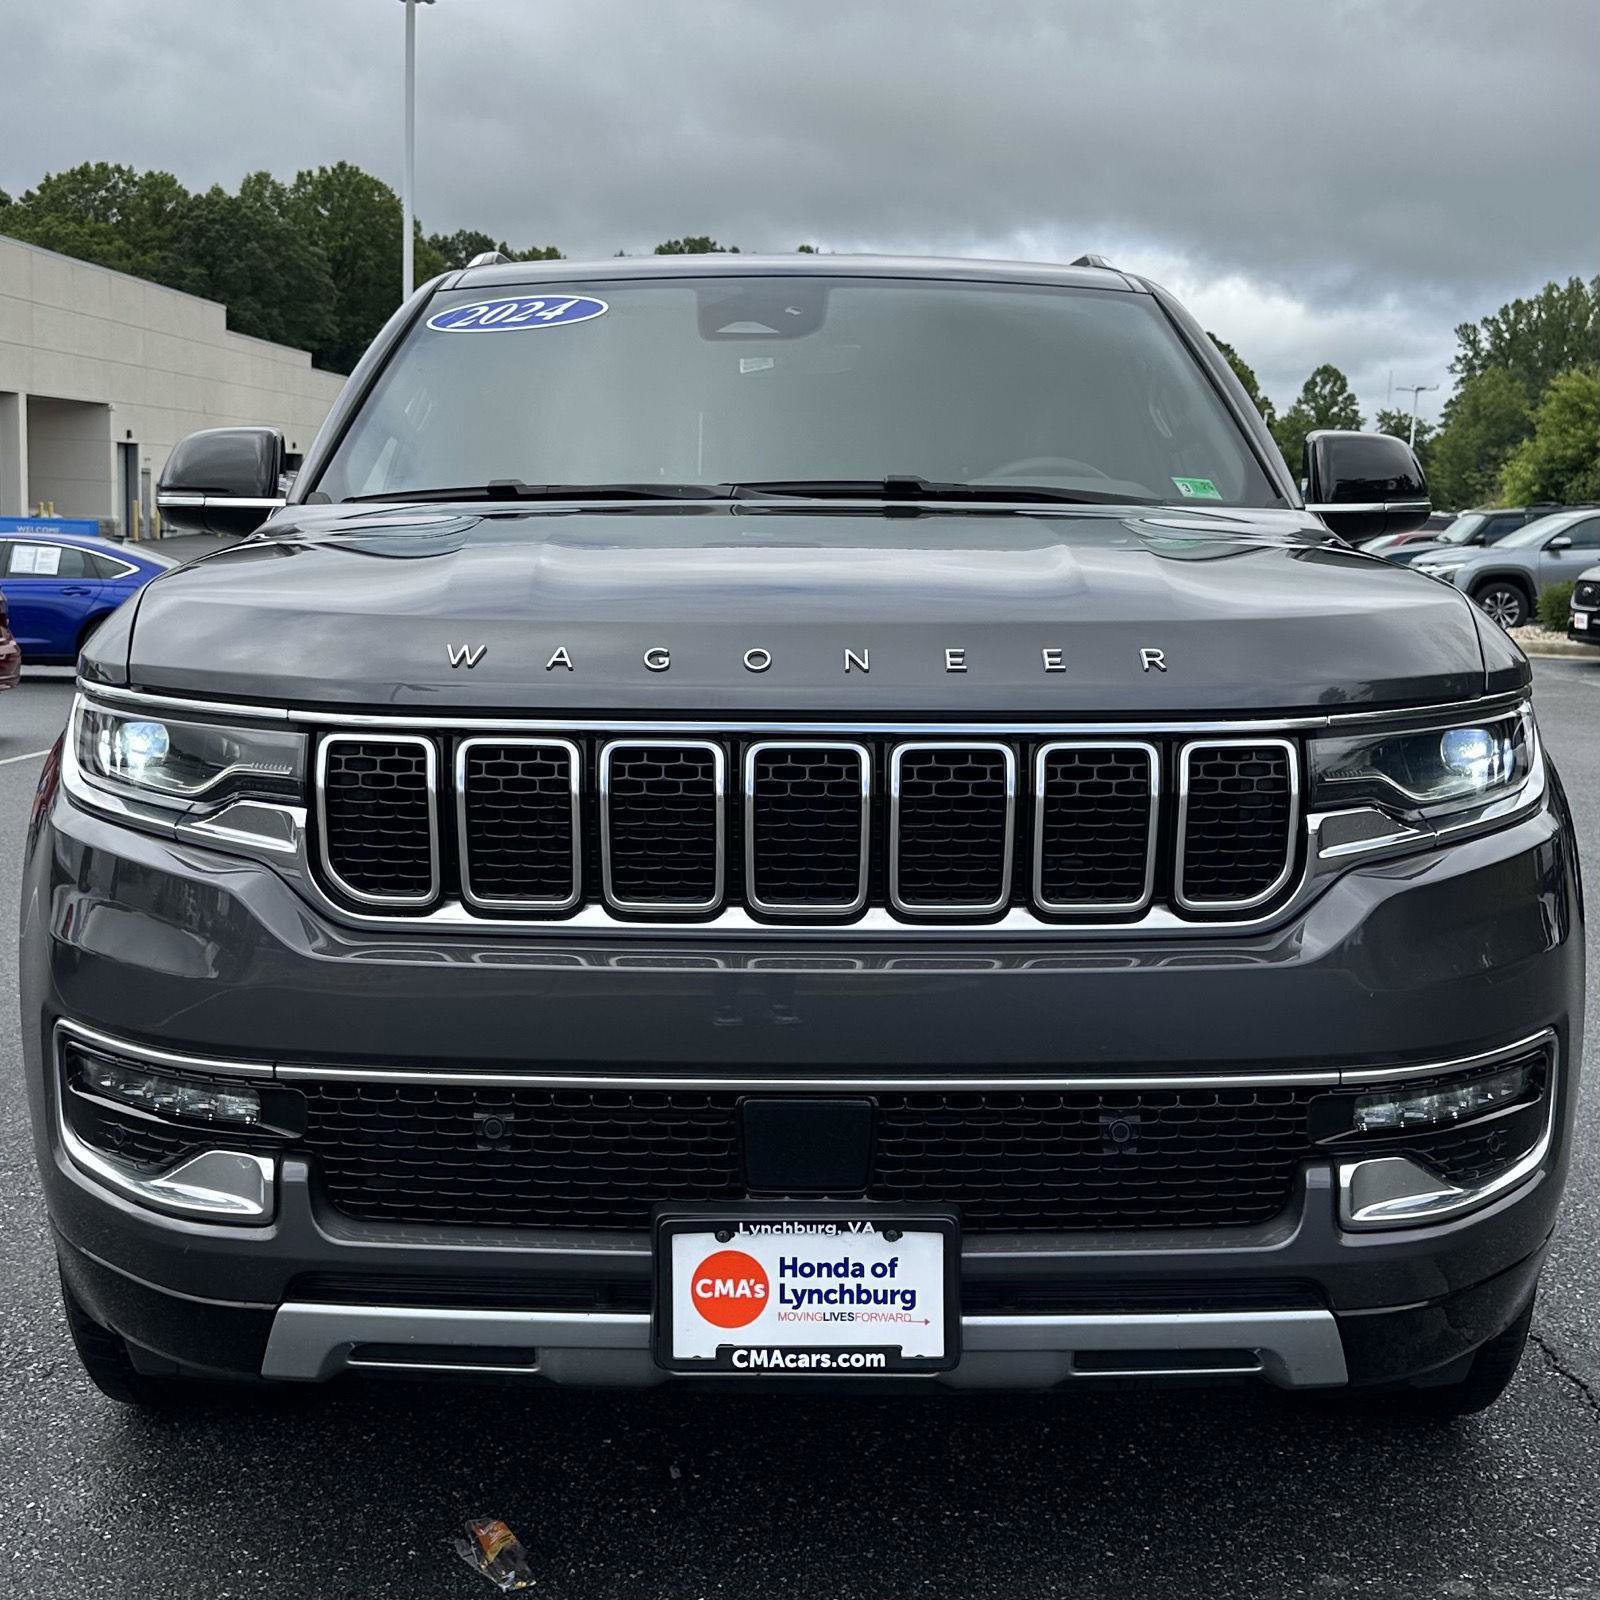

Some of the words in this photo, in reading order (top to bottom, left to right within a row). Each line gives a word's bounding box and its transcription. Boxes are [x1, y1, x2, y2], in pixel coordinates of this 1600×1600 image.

[446, 299, 581, 328] 2024
[17, 525, 60, 534] WELCOME
[447, 643, 1167, 673] WAGONEER
[738, 1222, 842, 1236] Lynchburg,
[848, 1221, 876, 1235] VA
[779, 1257, 864, 1278] Honda
[871, 1257, 898, 1278] of
[695, 1278, 766, 1299] CMA's
[779, 1284, 917, 1310] Lynchburg
[777, 1311, 912, 1323] MOVINGLIVESFORWARD
[731, 1350, 886, 1368] CMAcars.com
